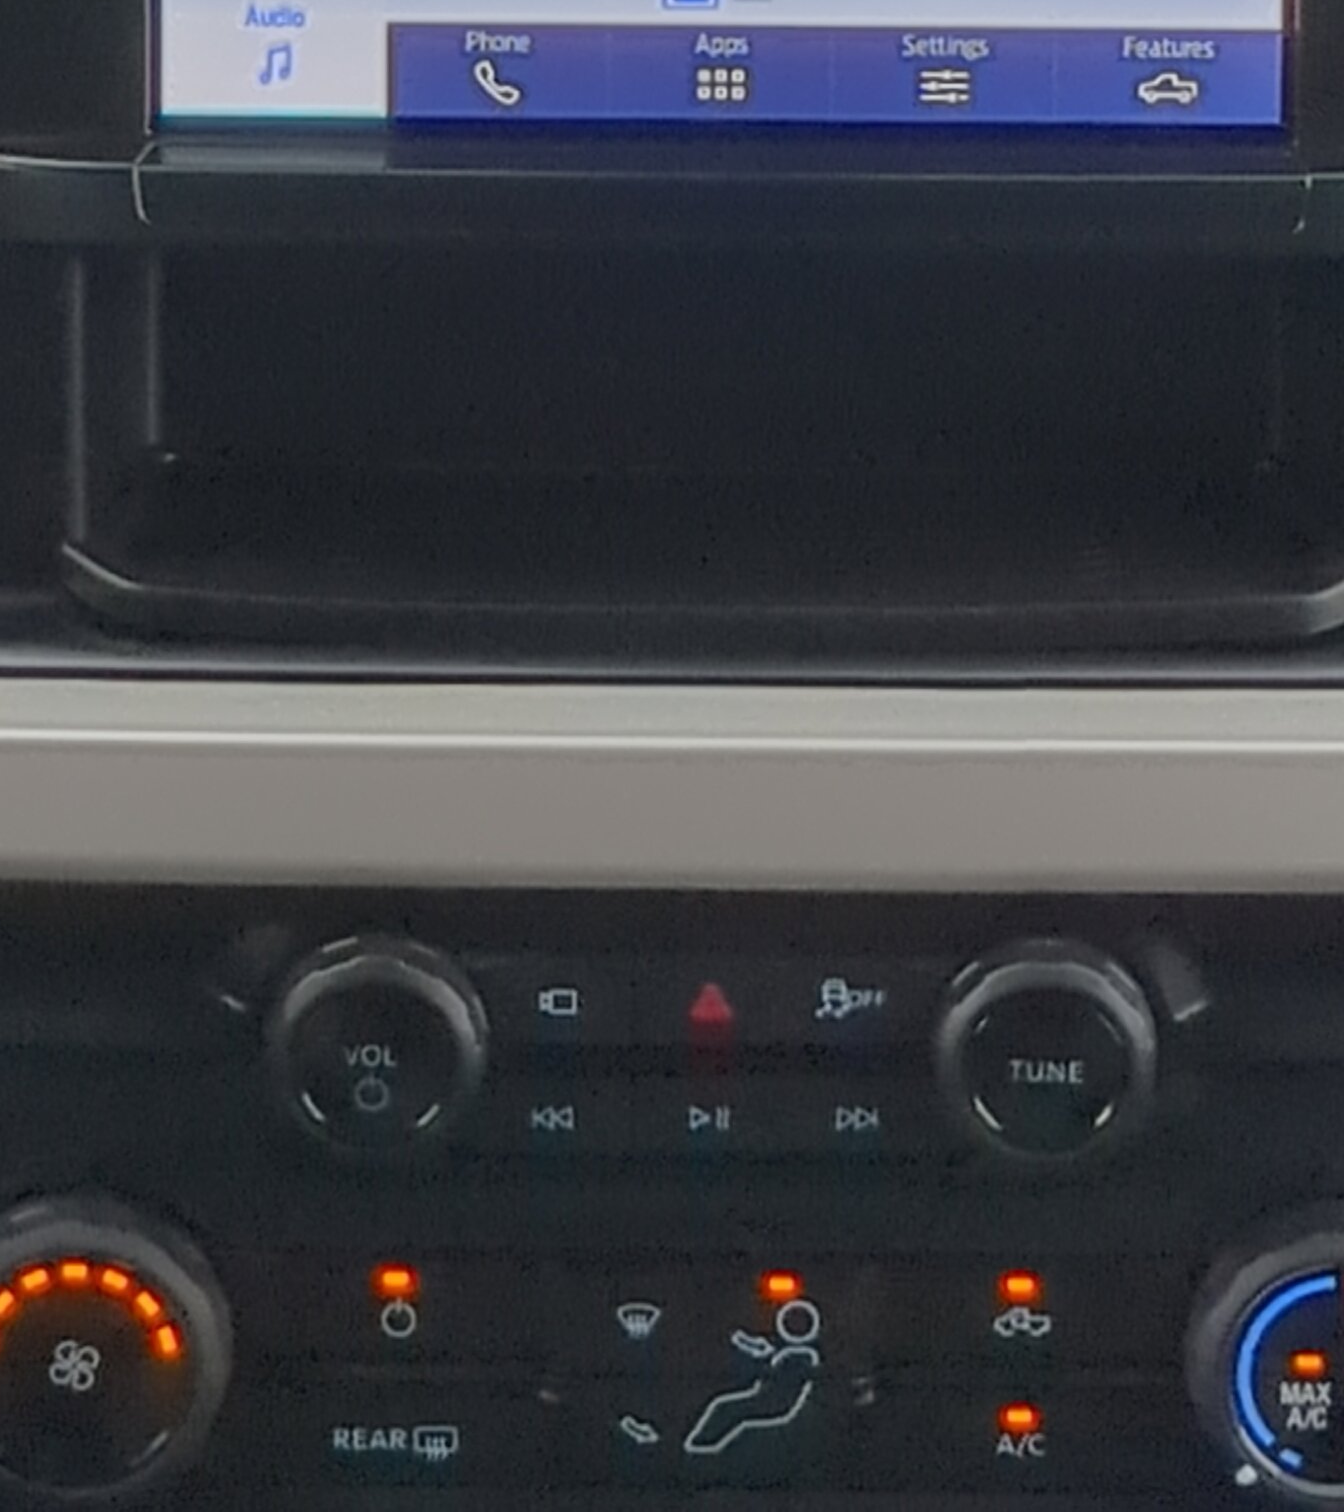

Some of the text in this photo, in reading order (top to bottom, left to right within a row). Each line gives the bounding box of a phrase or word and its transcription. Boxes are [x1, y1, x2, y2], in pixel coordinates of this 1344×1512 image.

[244, 4, 306, 29] Audio
[464, 31, 532, 54] Phone
[694, 33, 749, 58] Apps
[901, 34, 990, 61] Settings
[1122, 36, 1216, 60] Features
[848, 988, 889, 1009] OFF
[344, 1043, 398, 1069] VOL
[1007, 1059, 1085, 1086] TUNE
[1279, 1380, 1333, 1406] MAX
[1286, 1406, 1329, 1432] A/C
[332, 1426, 408, 1450] REAR
[996, 1433, 1047, 1458] A/C
